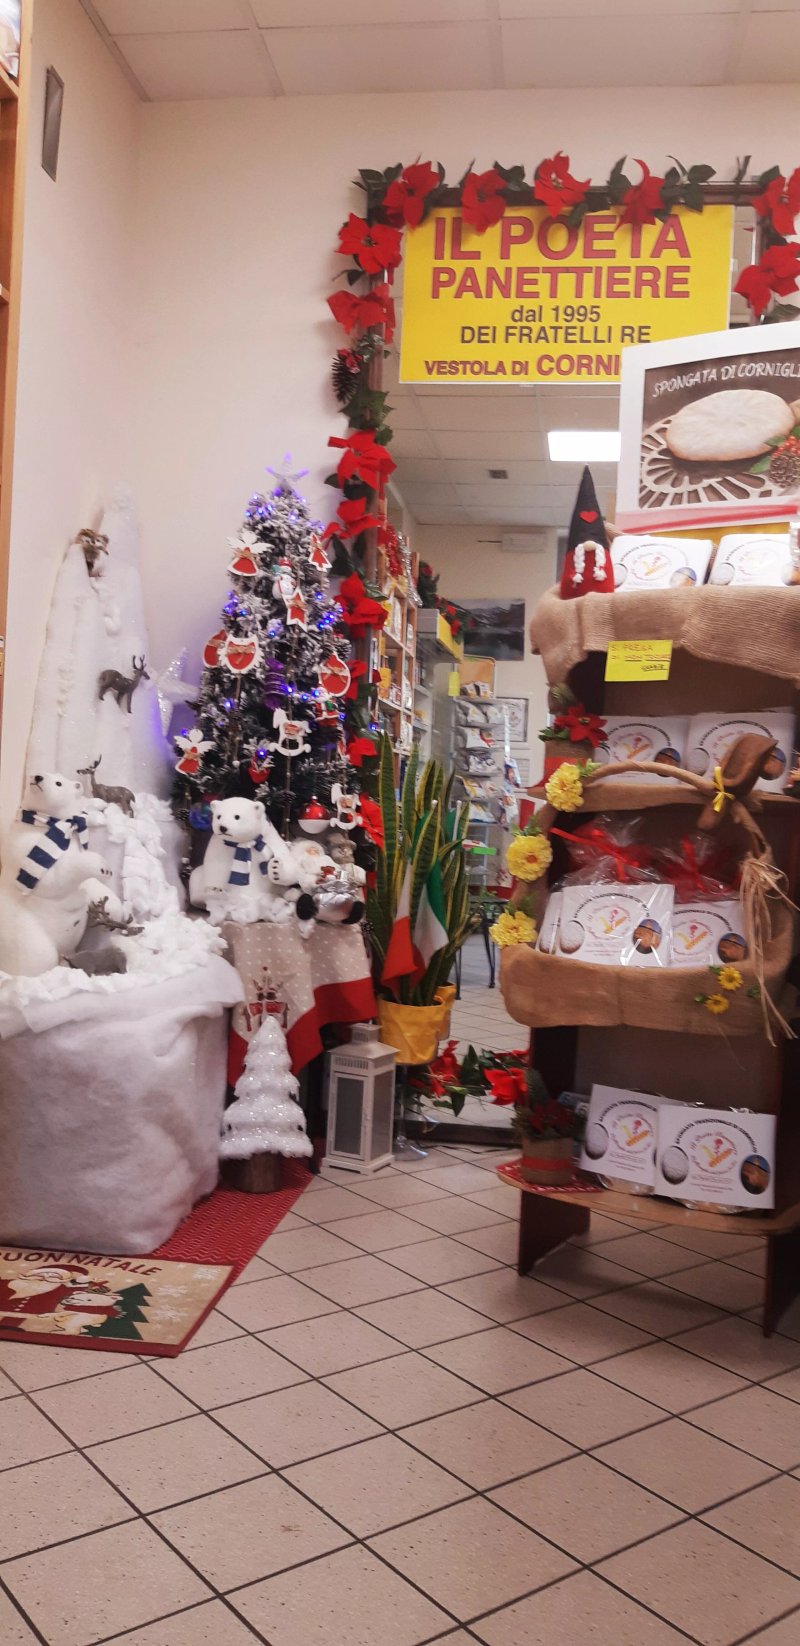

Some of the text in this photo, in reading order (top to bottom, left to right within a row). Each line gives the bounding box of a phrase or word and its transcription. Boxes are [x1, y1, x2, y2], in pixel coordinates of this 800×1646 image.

[434, 214, 691, 260] IL POETA
[431, 266, 690, 299] PANETTIERE
[511, 305, 601, 322] dal 1995
[461, 326, 651, 343] DEI FRATELLI RE
[424, 354, 620, 376] VESTOLA DI CORNI
[653, 368, 717, 398] SPONGATA
[720, 364, 736, 380] DI
[0, 1252, 162, 1276] UON NATALE
